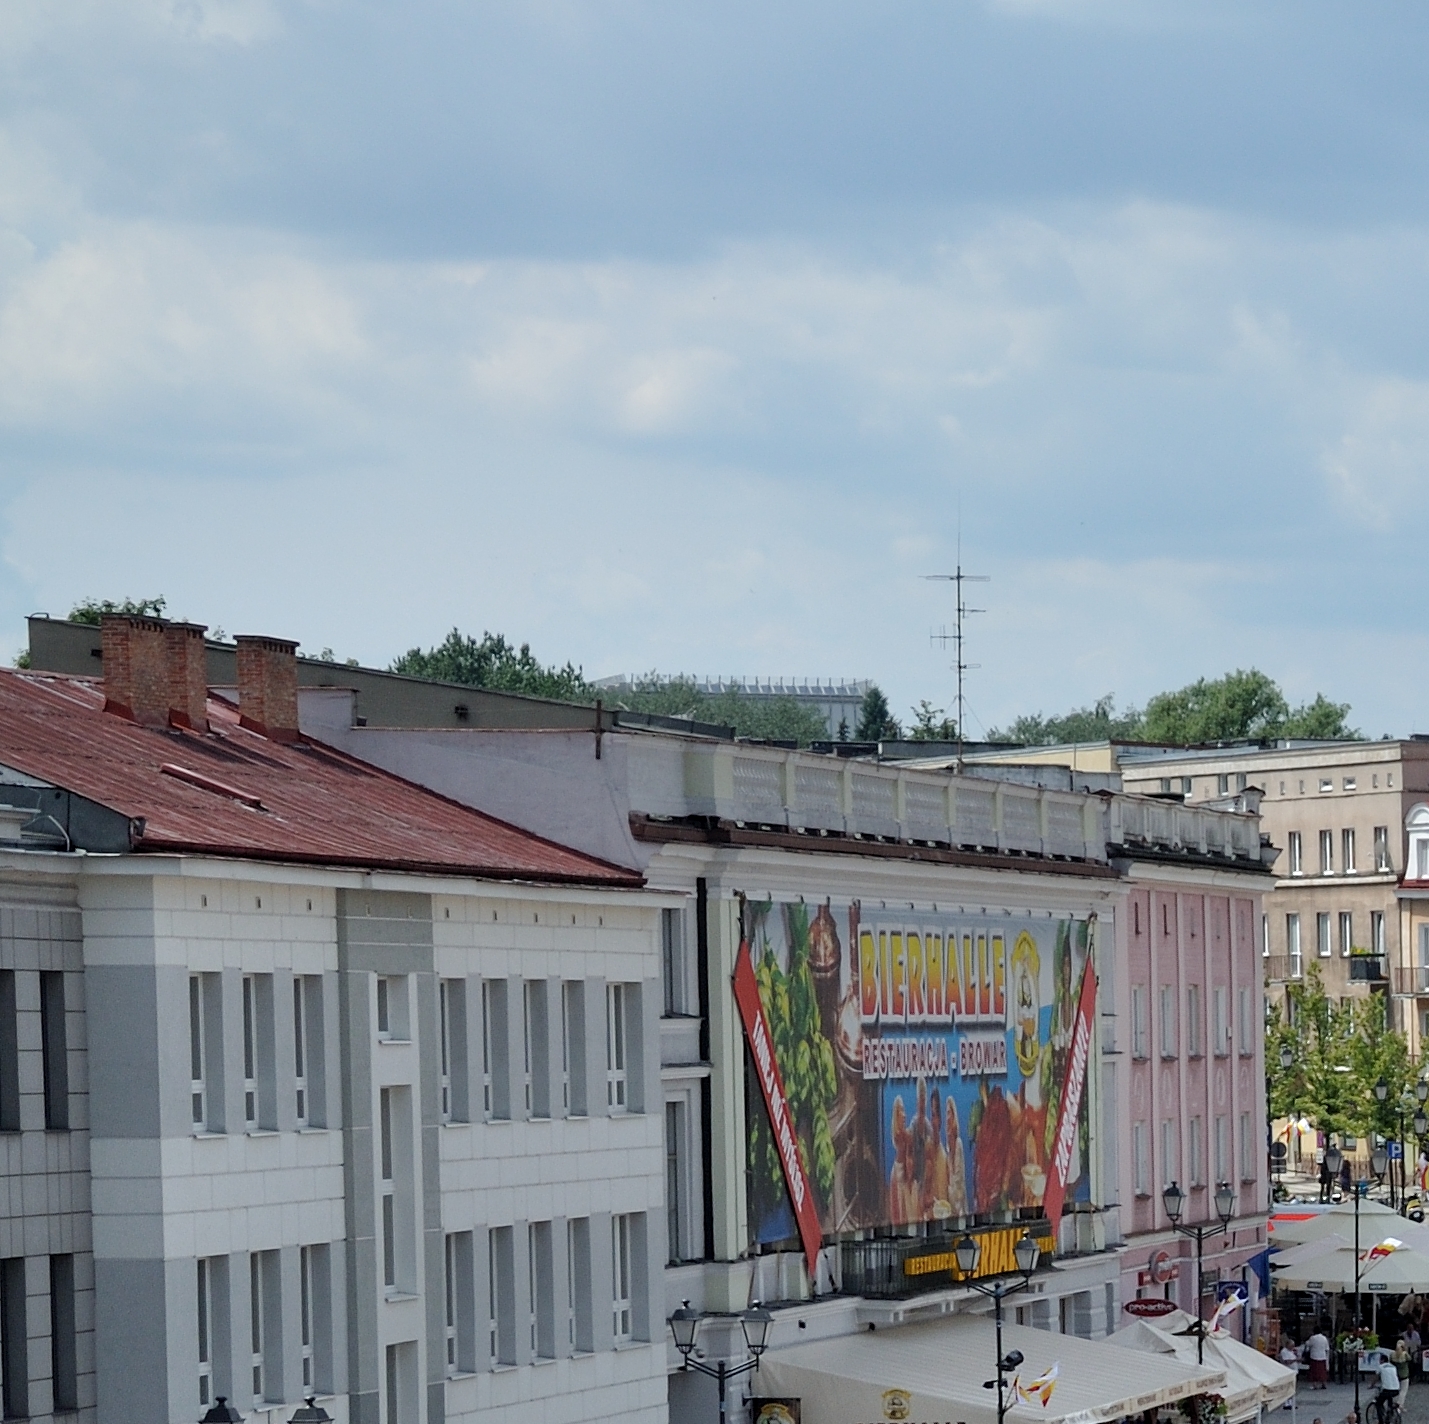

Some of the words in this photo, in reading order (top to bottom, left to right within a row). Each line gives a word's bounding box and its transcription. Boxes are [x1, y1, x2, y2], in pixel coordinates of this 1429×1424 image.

[859, 926, 1006, 1023] BIERHALLE
[863, 1038, 948, 1079] RESTAURACJA
[959, 1037, 1007, 1075] BROWAR
